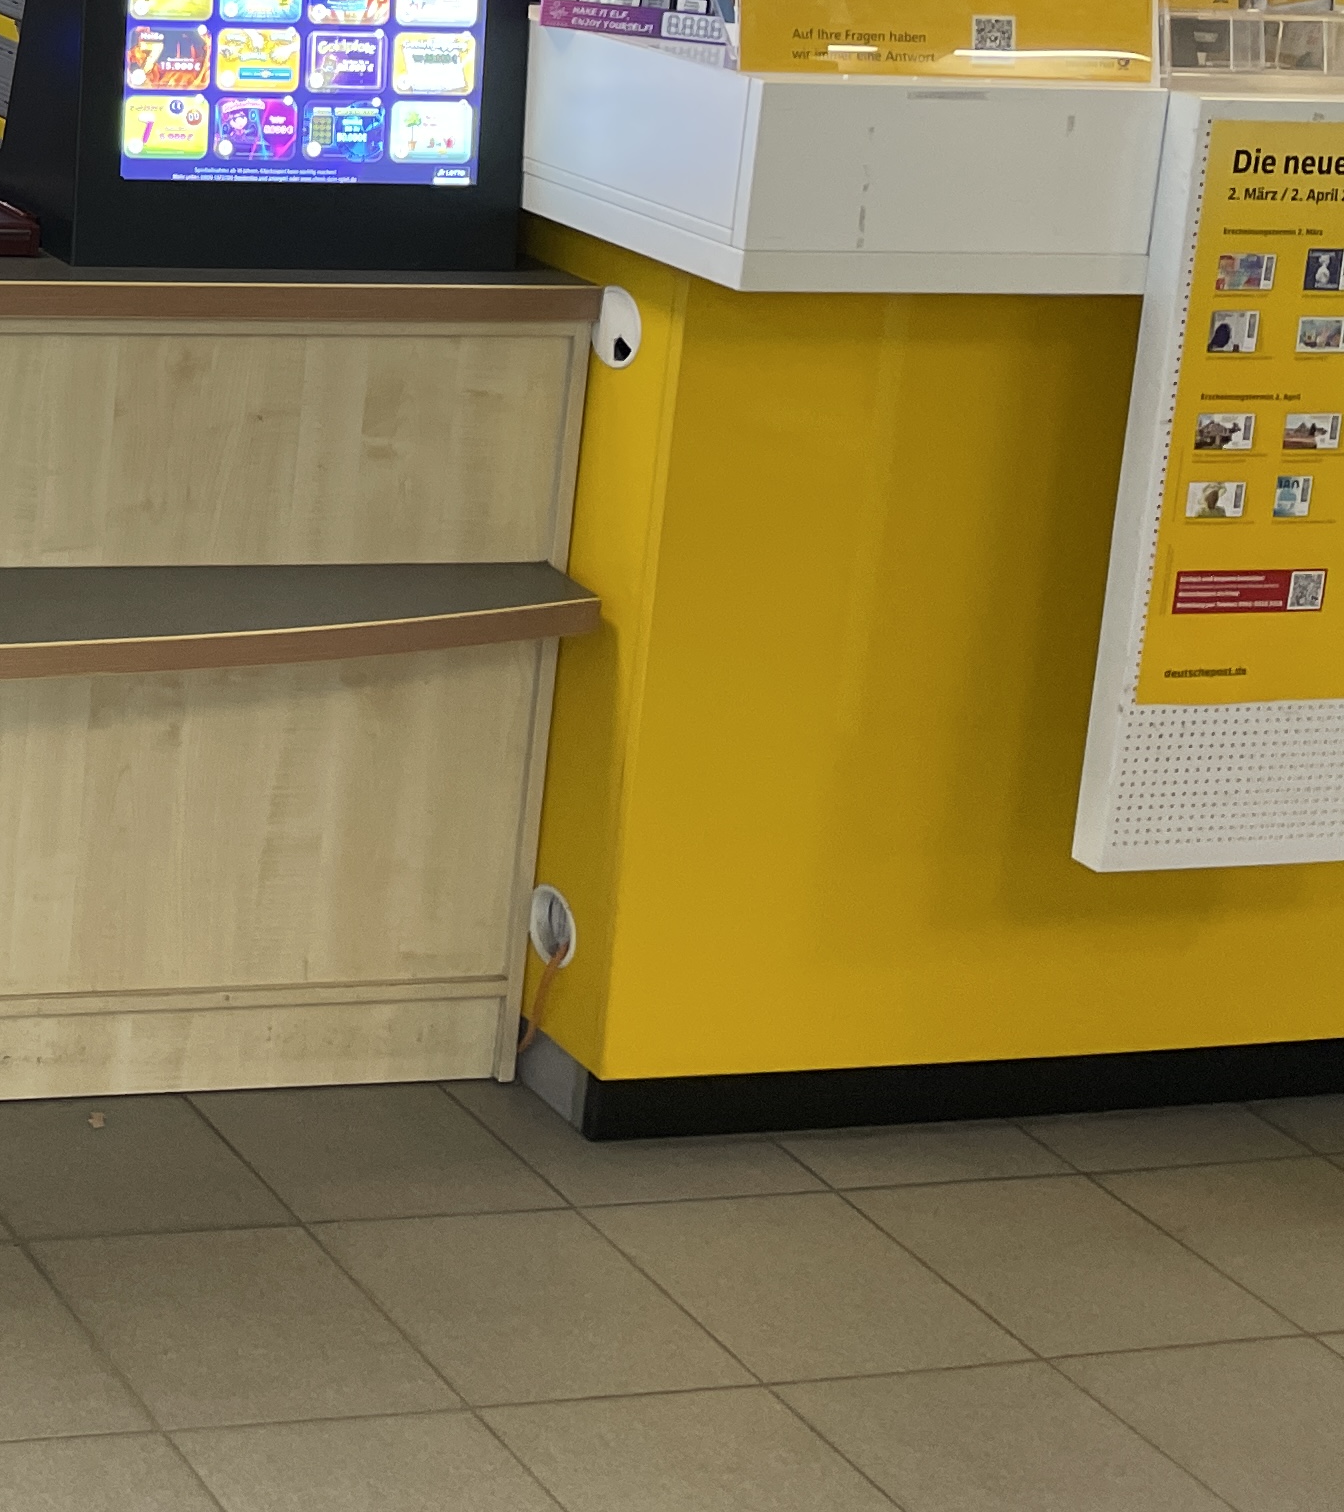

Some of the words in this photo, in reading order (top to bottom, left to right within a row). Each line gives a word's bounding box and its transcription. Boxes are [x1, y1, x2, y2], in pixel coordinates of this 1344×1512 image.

[792, 27, 813, 41] Auf
[817, 28, 841, 42] Ihre
[845, 29, 886, 44] Fragen
[889, 30, 927, 44] haben
[1232, 148, 1277, 175] Die
[1283, 154, 1344, 176] neue
[1228, 188, 1240, 201] 2.
[1244, 188, 1278, 202] März
[1291, 188, 1303, 202] 2.
[1306, 188, 1338, 205] April
